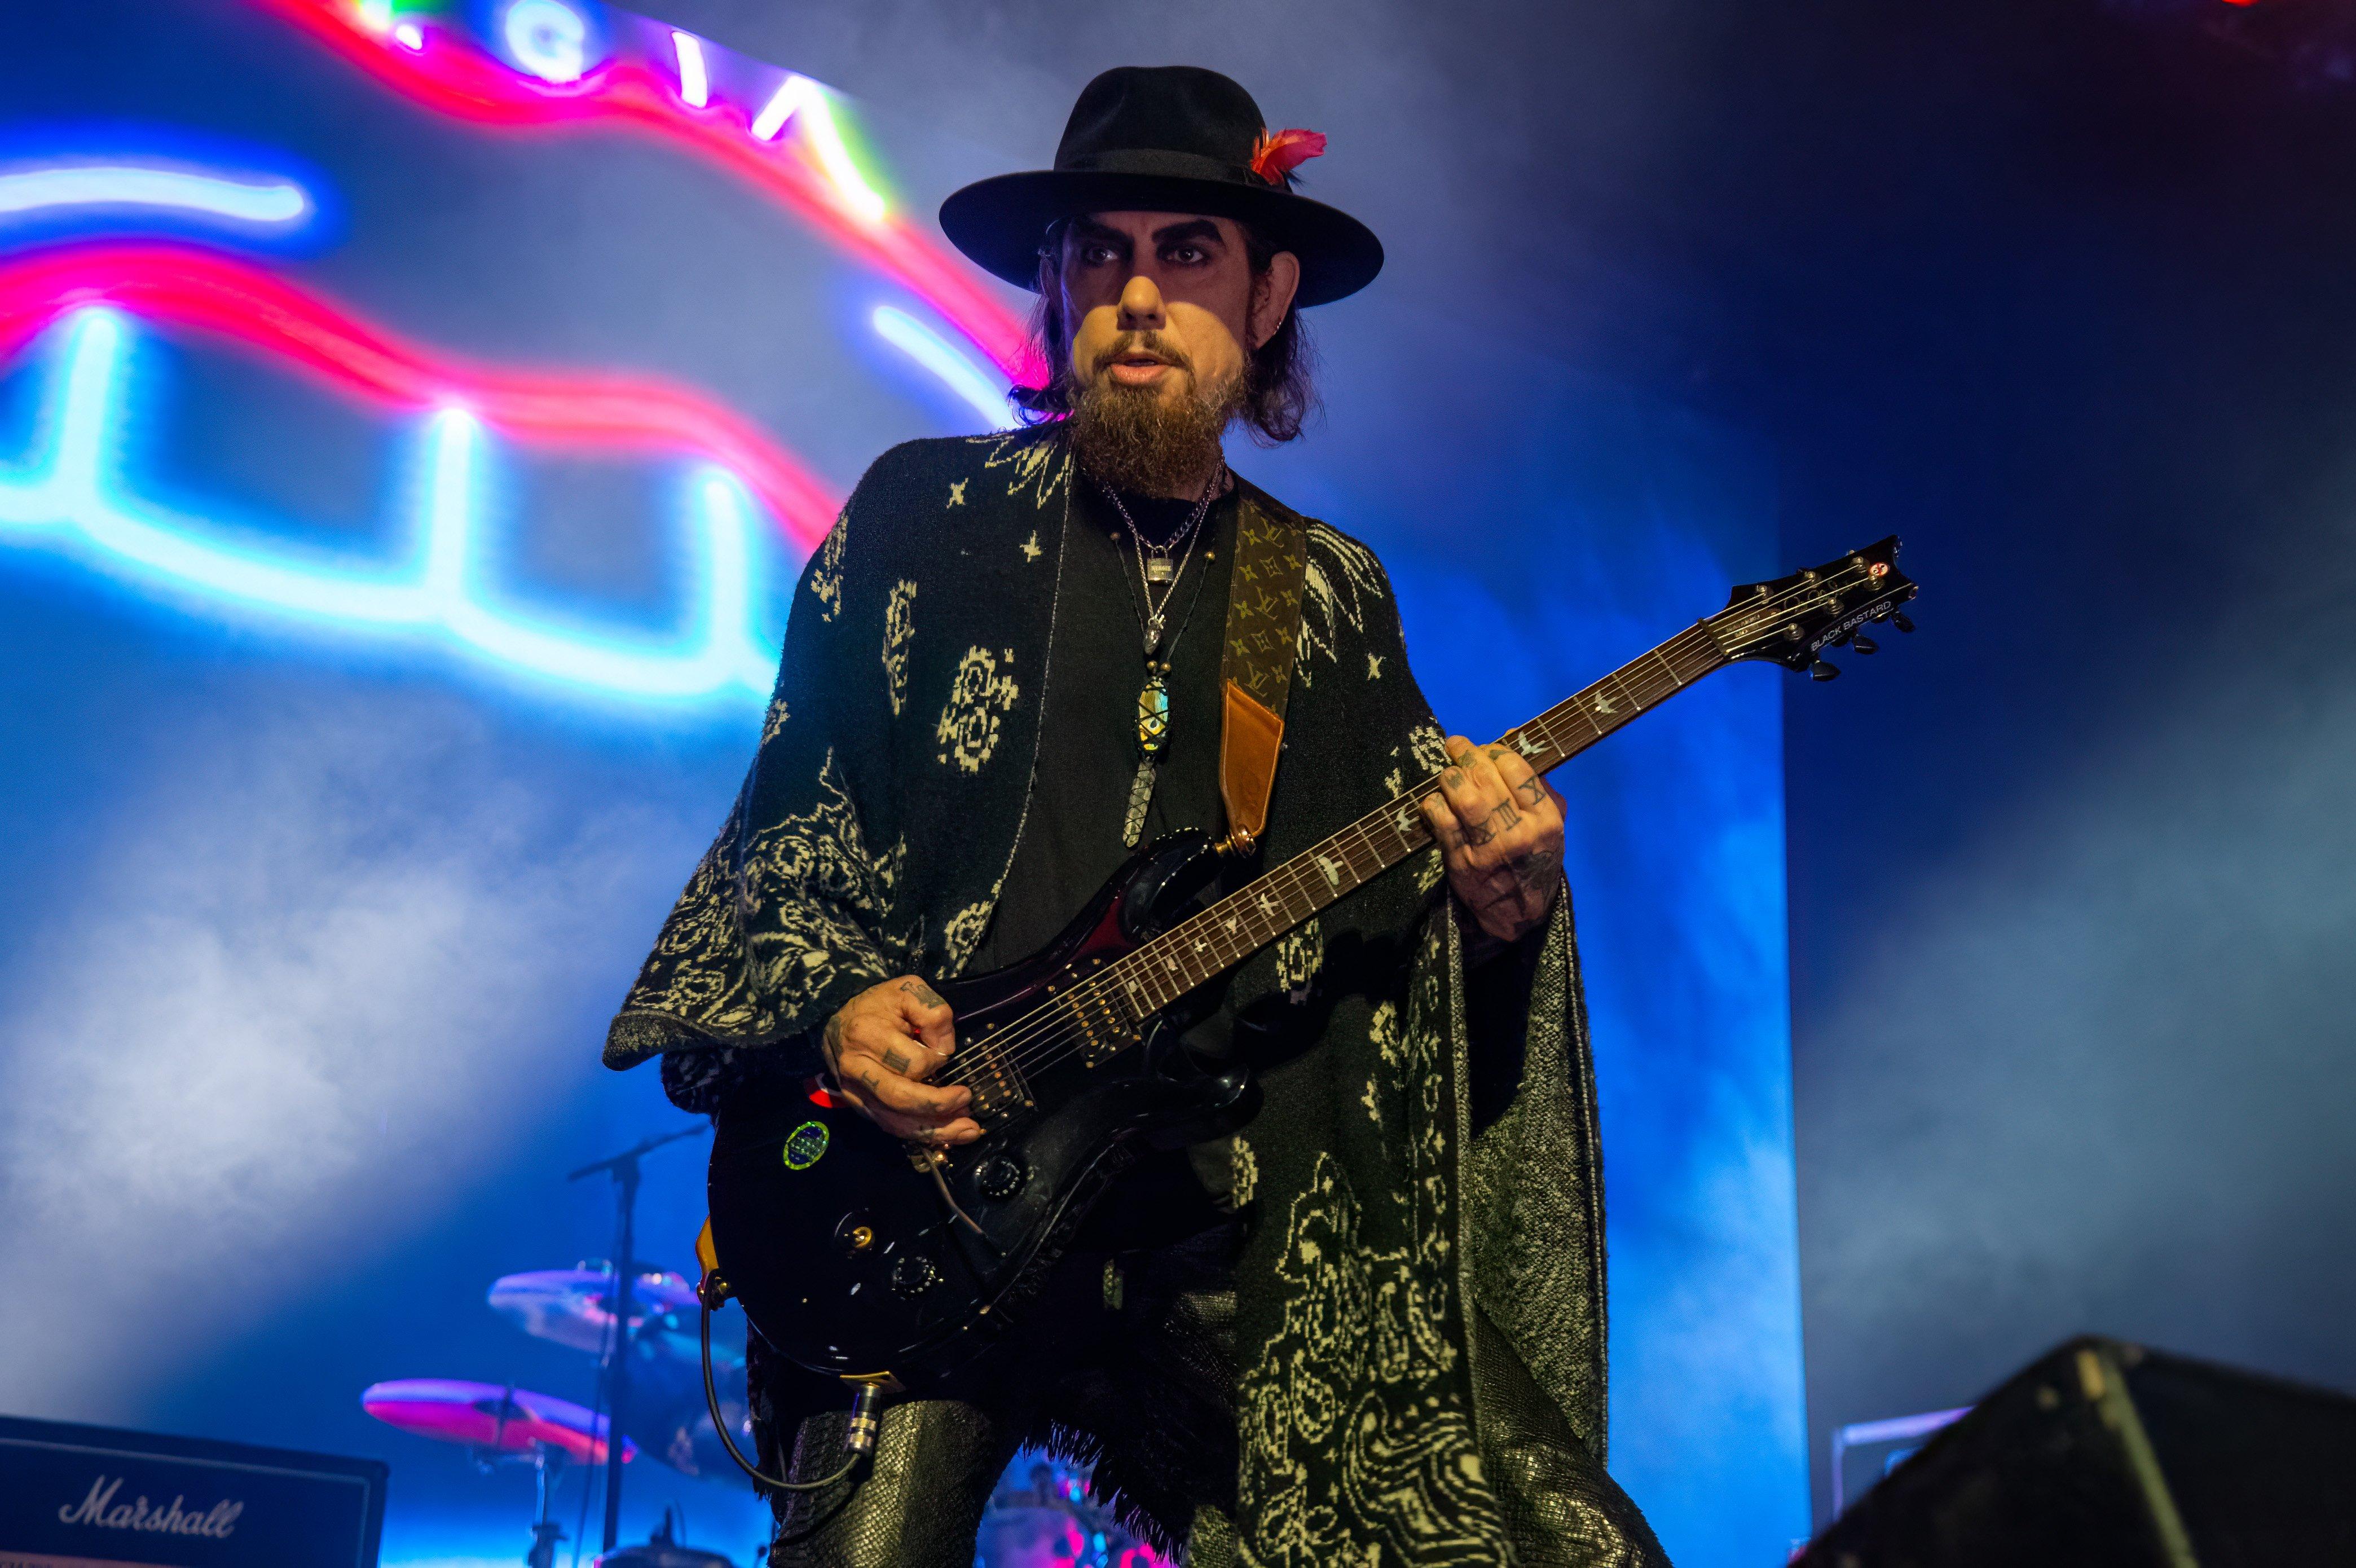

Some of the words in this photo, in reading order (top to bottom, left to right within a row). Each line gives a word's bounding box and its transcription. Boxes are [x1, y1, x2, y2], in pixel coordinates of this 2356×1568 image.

[1811, 626, 1842, 651] BLACK
[1843, 601, 1891, 630] BASTARD
[58, 1474, 244, 1539] Marshall
